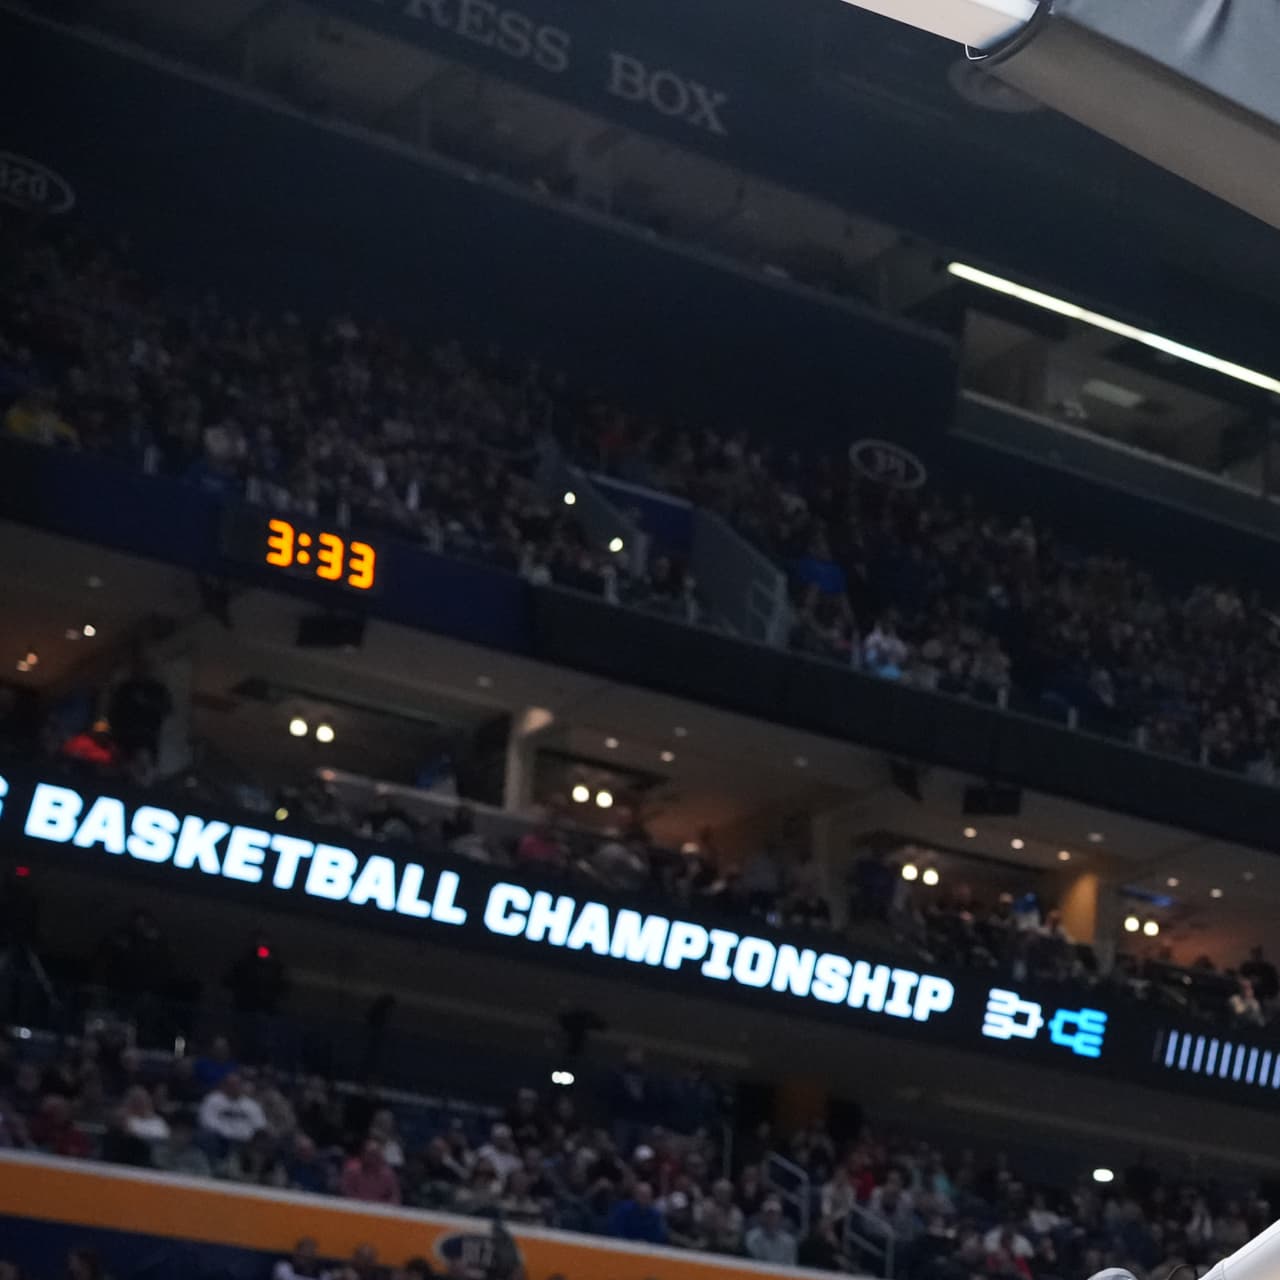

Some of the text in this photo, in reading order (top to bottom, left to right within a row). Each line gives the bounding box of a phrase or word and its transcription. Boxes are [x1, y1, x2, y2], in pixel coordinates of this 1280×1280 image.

[369, 0, 729, 135] RESS BOX
[266, 519, 375, 589] 3:33
[24, 781, 955, 1023] BASKETBALL CHAMPIONSHIP
